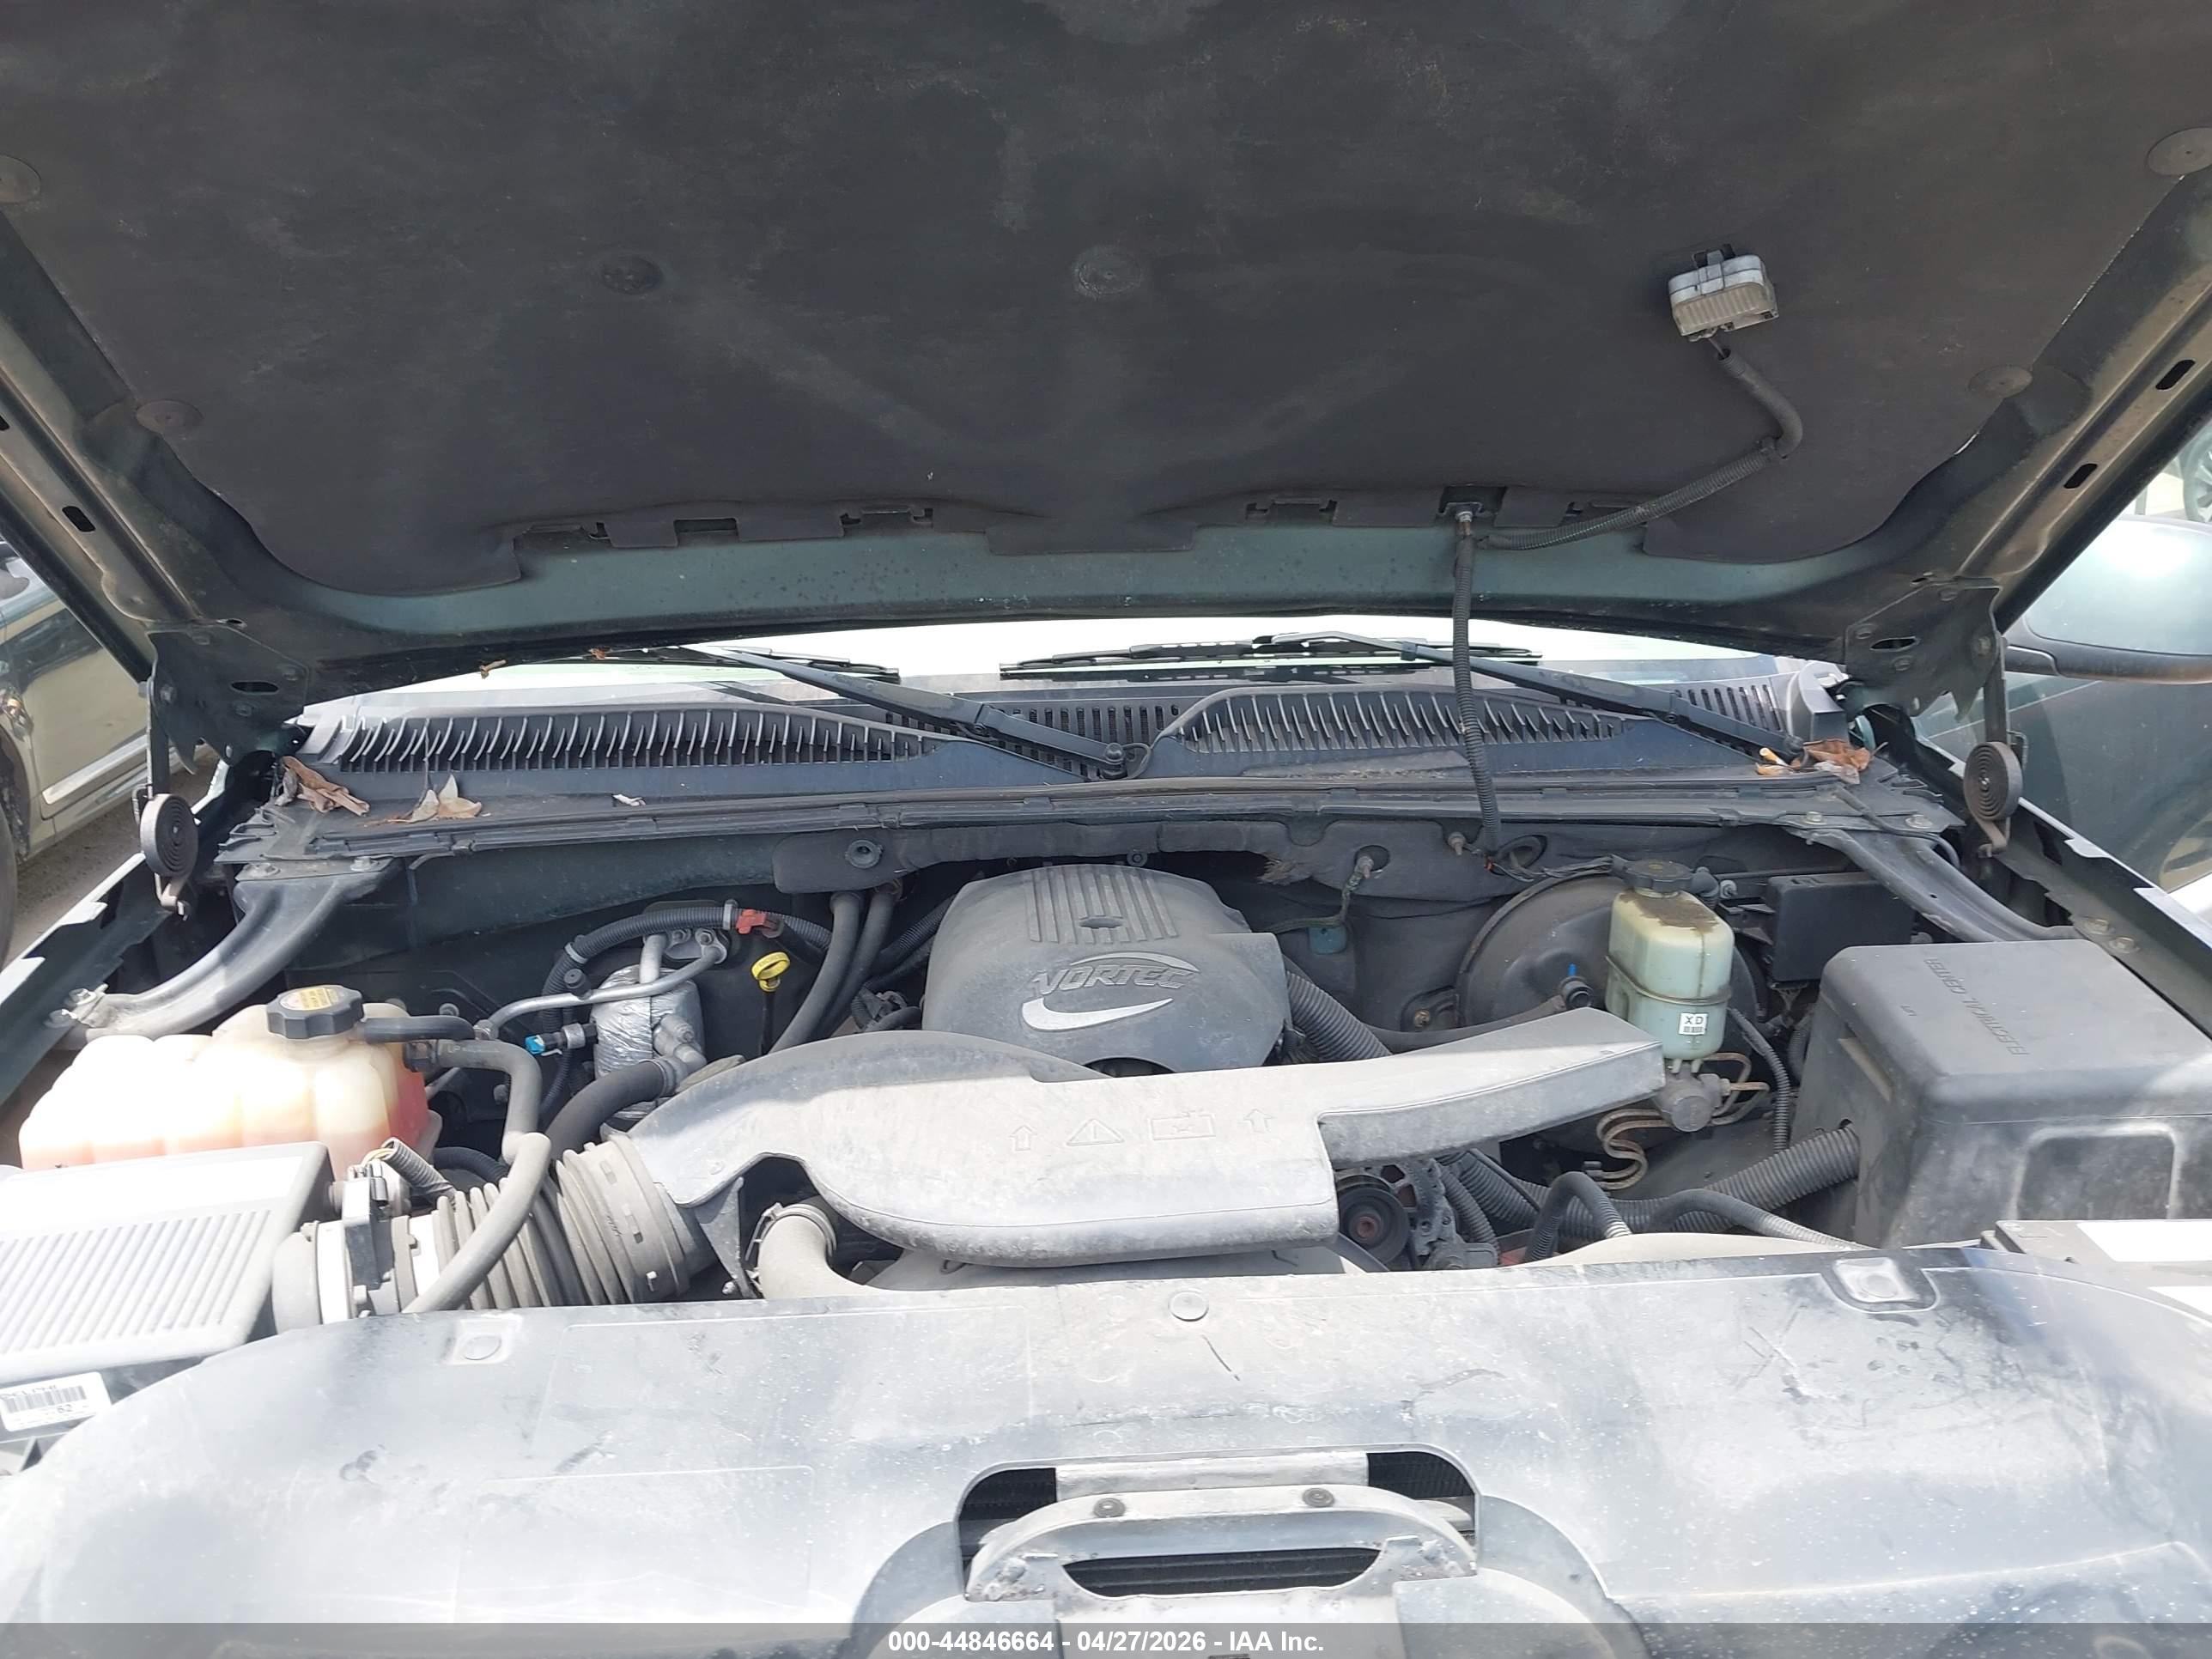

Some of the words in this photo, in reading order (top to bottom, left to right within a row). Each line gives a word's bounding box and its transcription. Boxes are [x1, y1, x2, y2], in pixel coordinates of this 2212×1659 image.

[1030, 964, 1194, 995] VORTEC
[1923, 957, 1966, 994] CENTER
[1962, 997, 2031, 1055] ELECTRICAL
